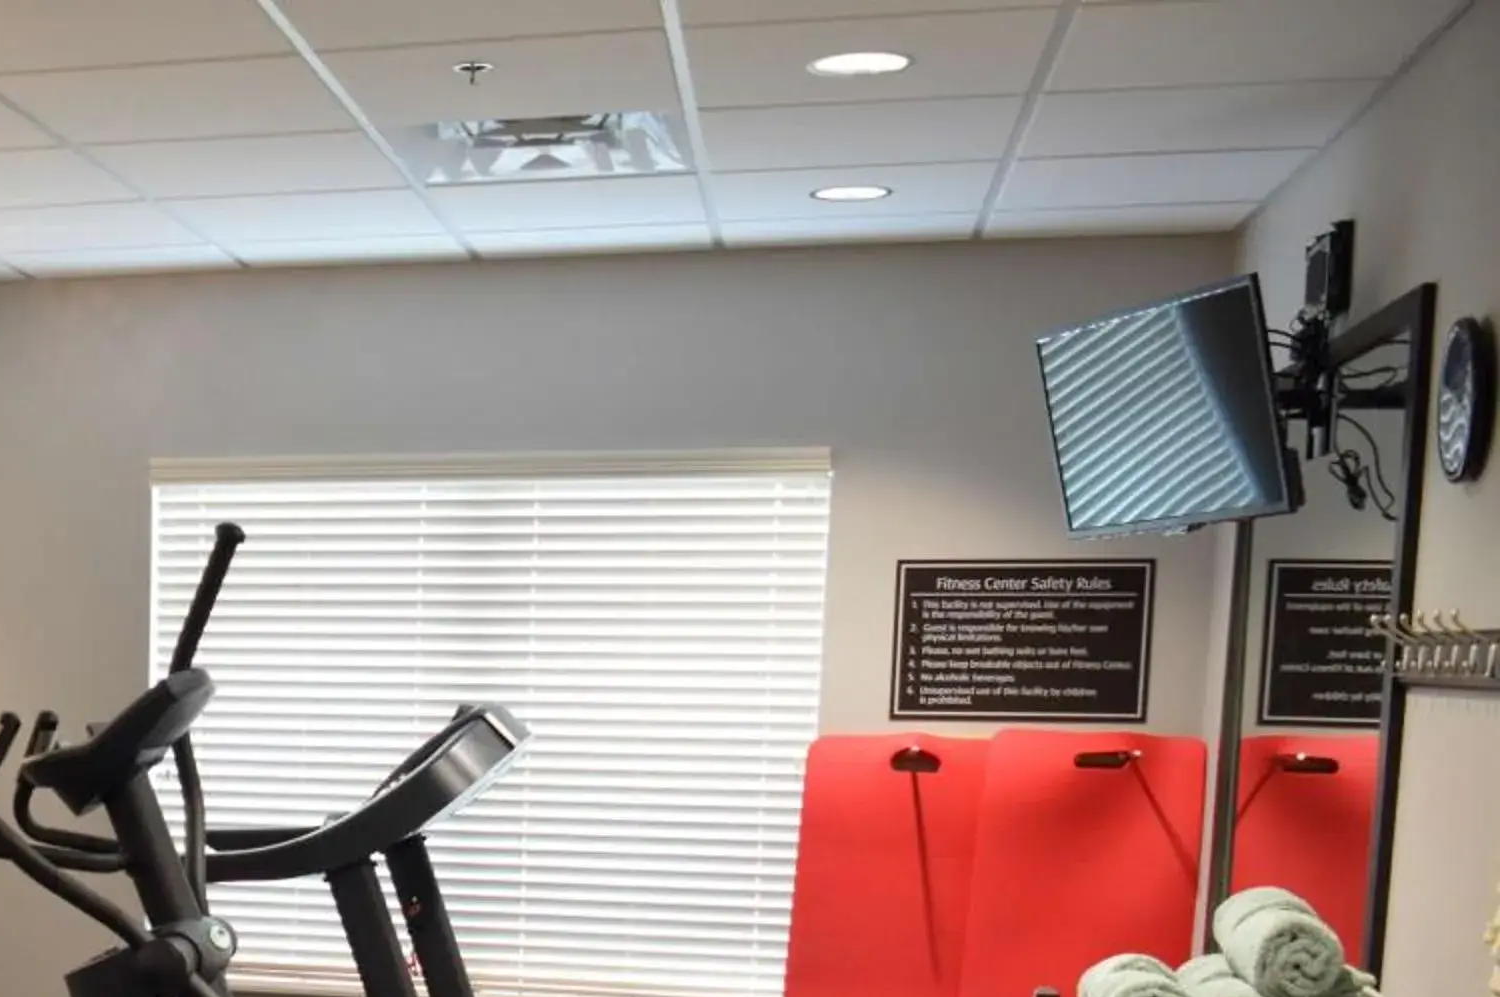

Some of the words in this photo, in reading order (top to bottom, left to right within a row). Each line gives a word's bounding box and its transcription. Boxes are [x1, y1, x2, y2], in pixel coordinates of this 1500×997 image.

[936, 577, 981, 591] Fitness
[984, 577, 1028, 591] Center
[1031, 577, 1073, 593] Safety
[1077, 577, 1112, 591] Rules
